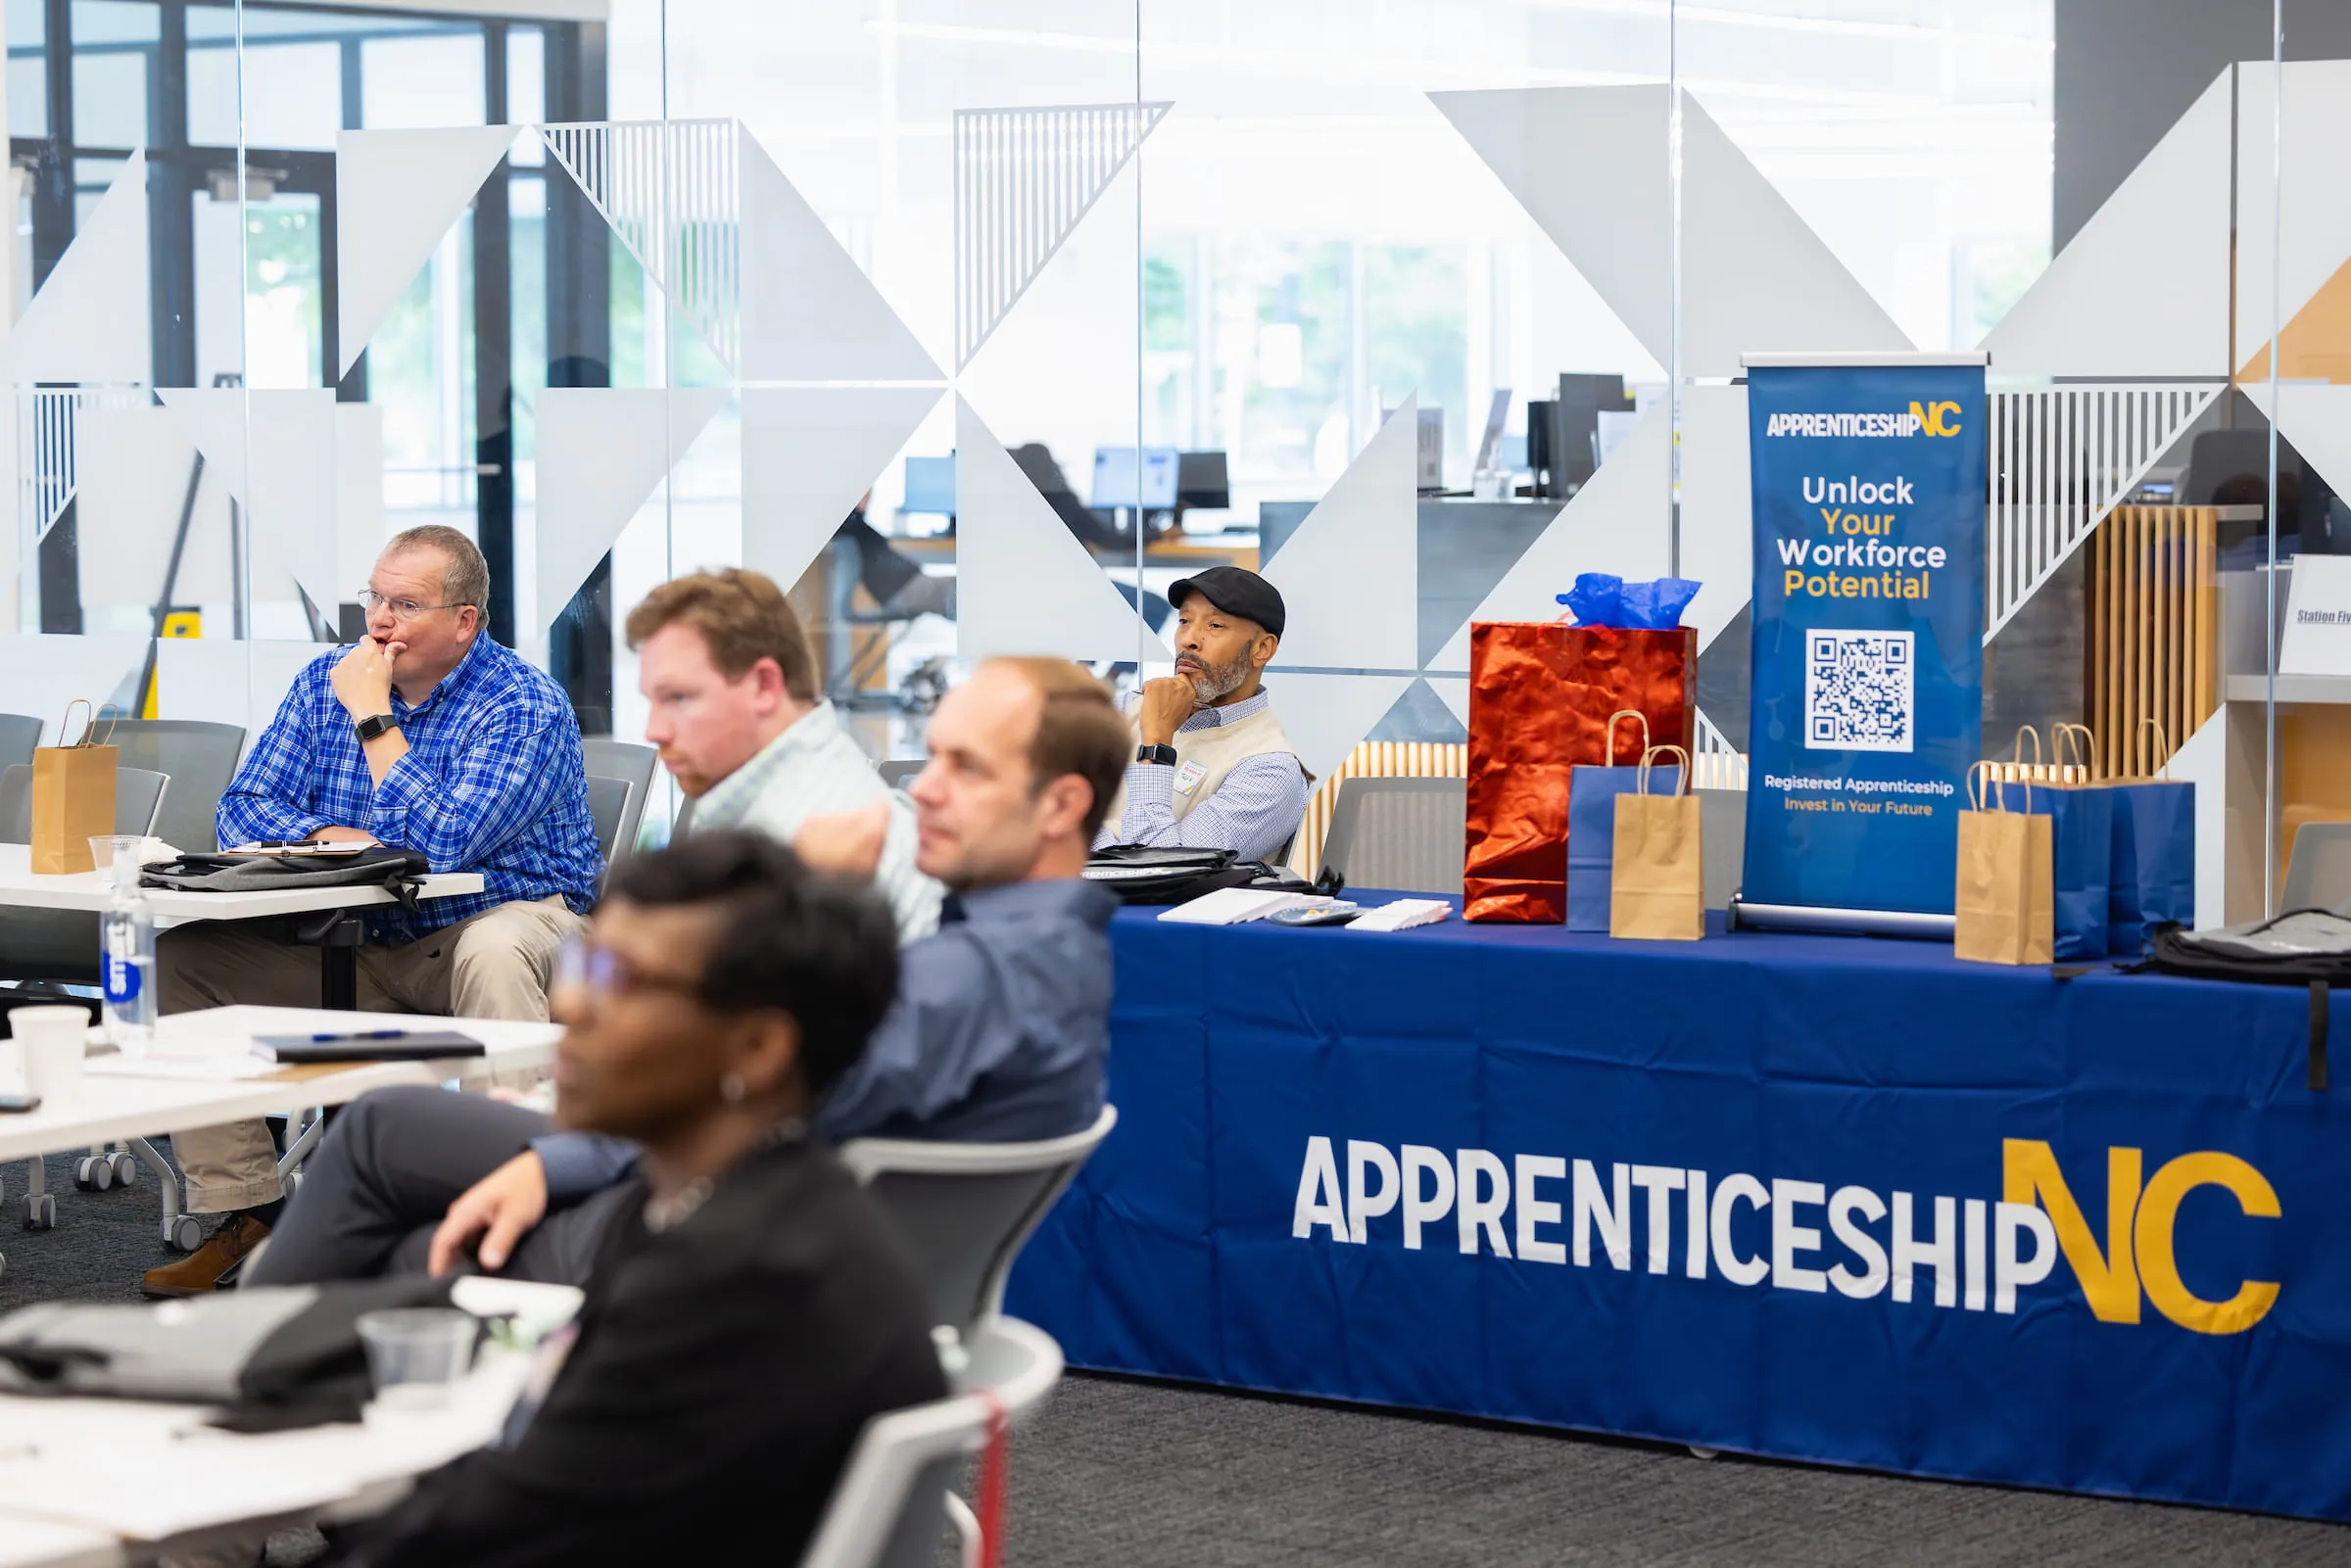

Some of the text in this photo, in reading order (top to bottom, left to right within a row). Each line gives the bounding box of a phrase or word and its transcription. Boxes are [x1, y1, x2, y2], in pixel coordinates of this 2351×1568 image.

[1802, 475, 1914, 504] Unlock
[1820, 508, 1895, 535] Your
[1776, 538, 1947, 568] Workforce
[1784, 569, 1930, 599] Potential
[2297, 609, 2335, 624] Station
[1764, 775, 1954, 797] Registered Apprenticeship
[1784, 797, 1933, 816] Invest in Your Future
